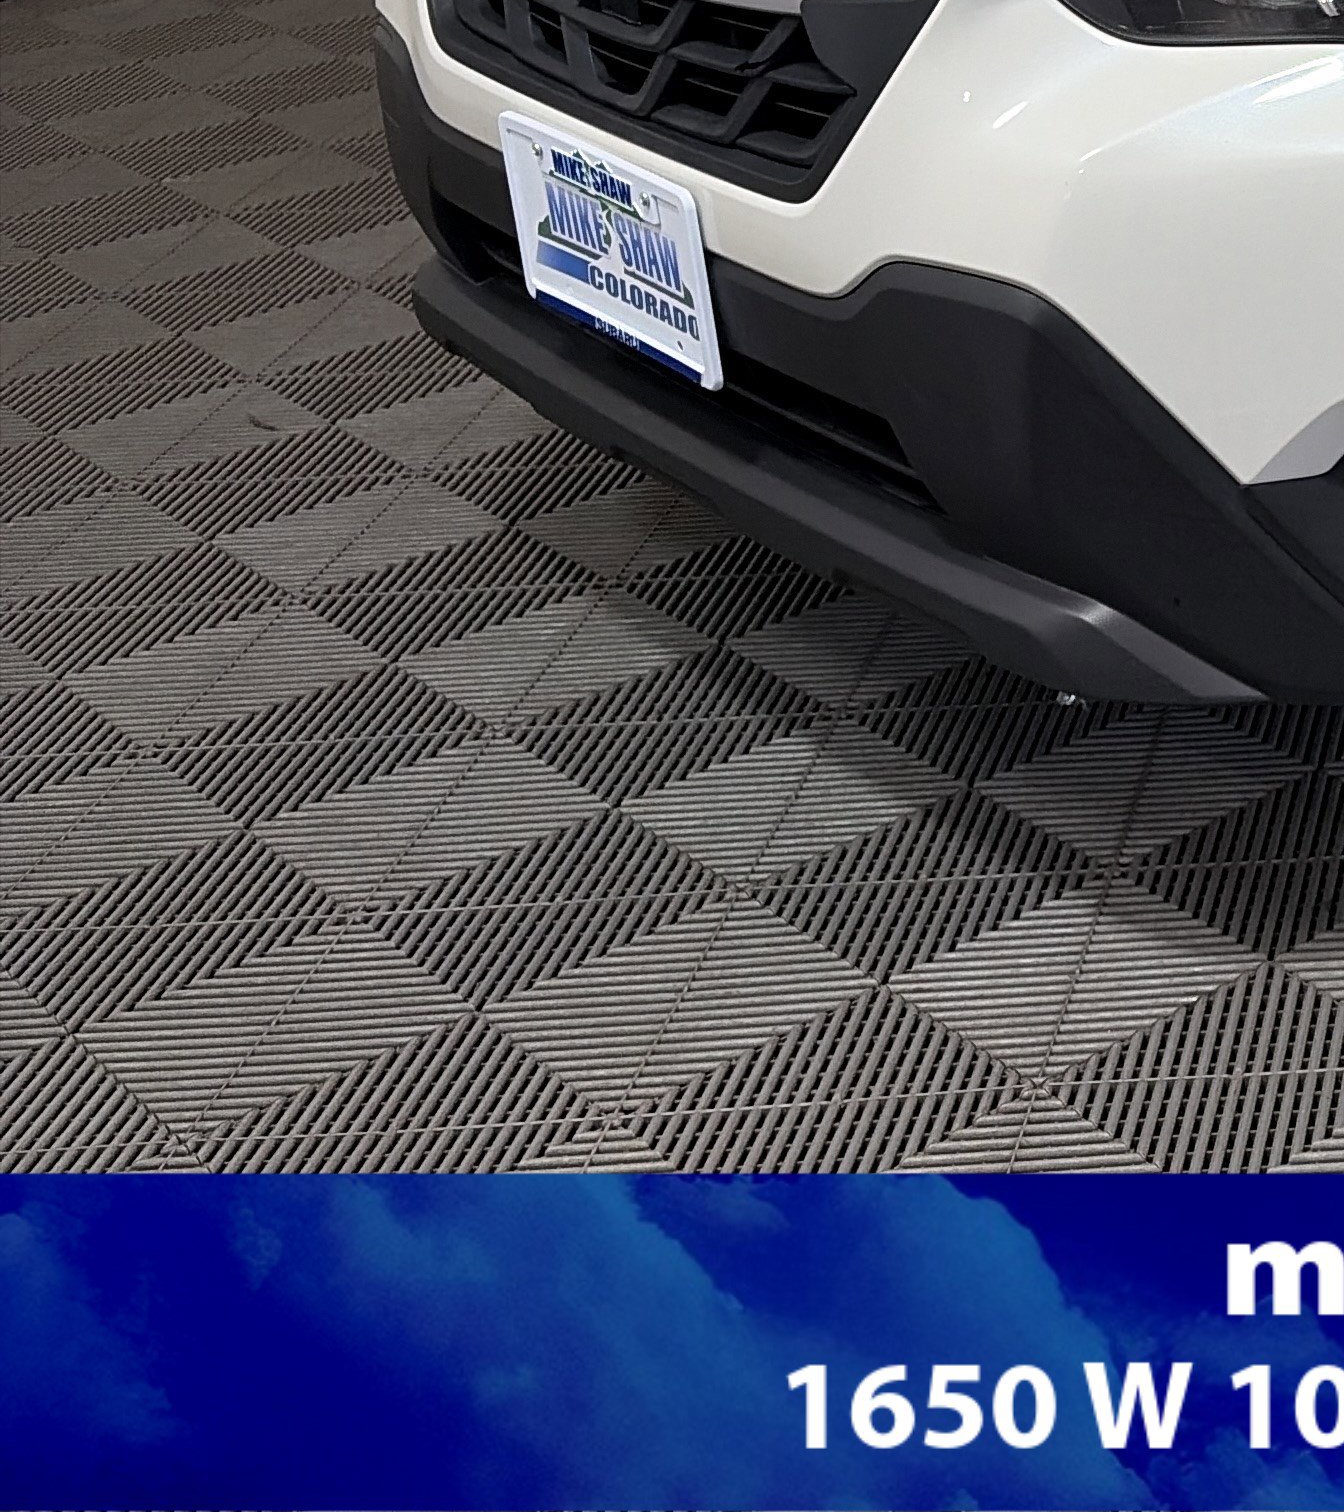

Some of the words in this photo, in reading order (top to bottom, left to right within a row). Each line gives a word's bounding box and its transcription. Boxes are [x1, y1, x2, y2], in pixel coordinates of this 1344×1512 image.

[550, 148, 589, 188] MIKE
[590, 166, 632, 208] SHAW
[544, 180, 610, 256] MIKE
[612, 211, 682, 294] SHAW
[589, 264, 701, 342] COLORADO
